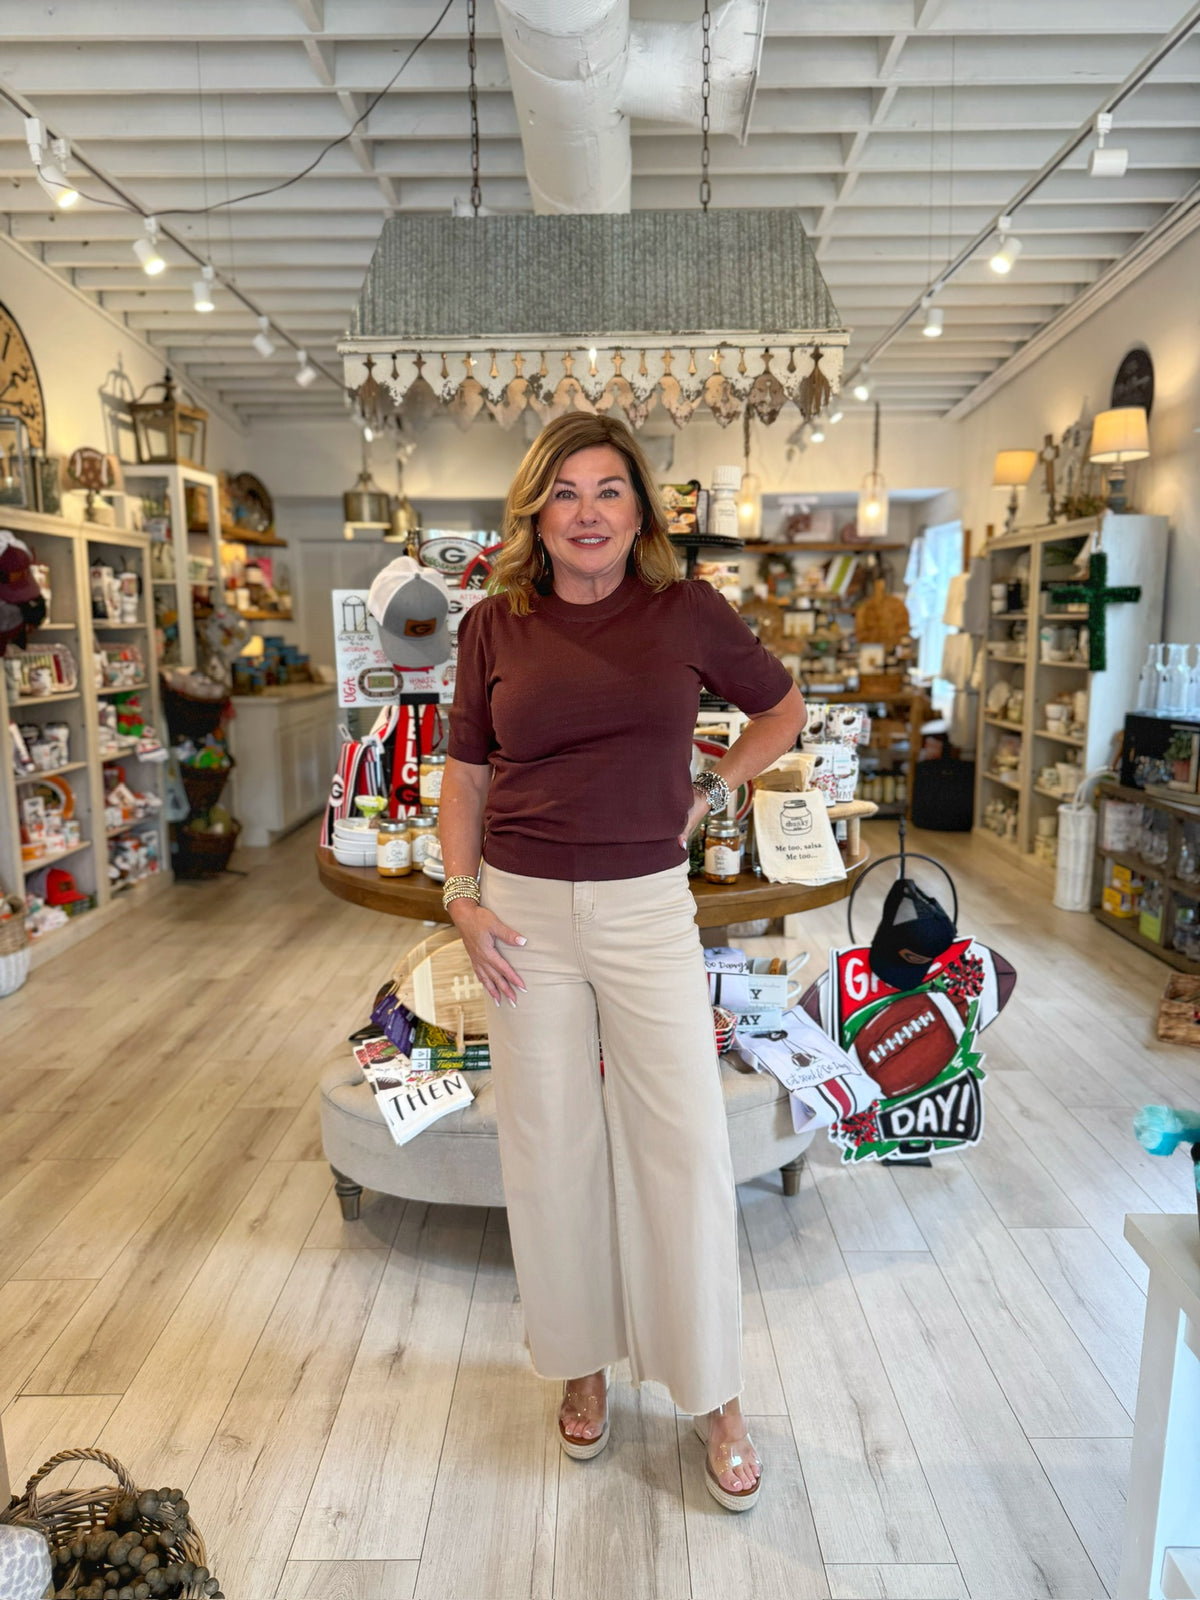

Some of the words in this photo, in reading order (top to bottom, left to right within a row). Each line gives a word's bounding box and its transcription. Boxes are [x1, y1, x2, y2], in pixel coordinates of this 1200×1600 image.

[438, 547, 467, 564] G
[408, 624, 432, 636] G
[343, 677, 356, 703] UGA
[331, 781, 343, 800] G
[750, 988, 763, 1000] Y
[388, 1075, 462, 1121] THEN
[890, 1084, 970, 1136] DAY!
